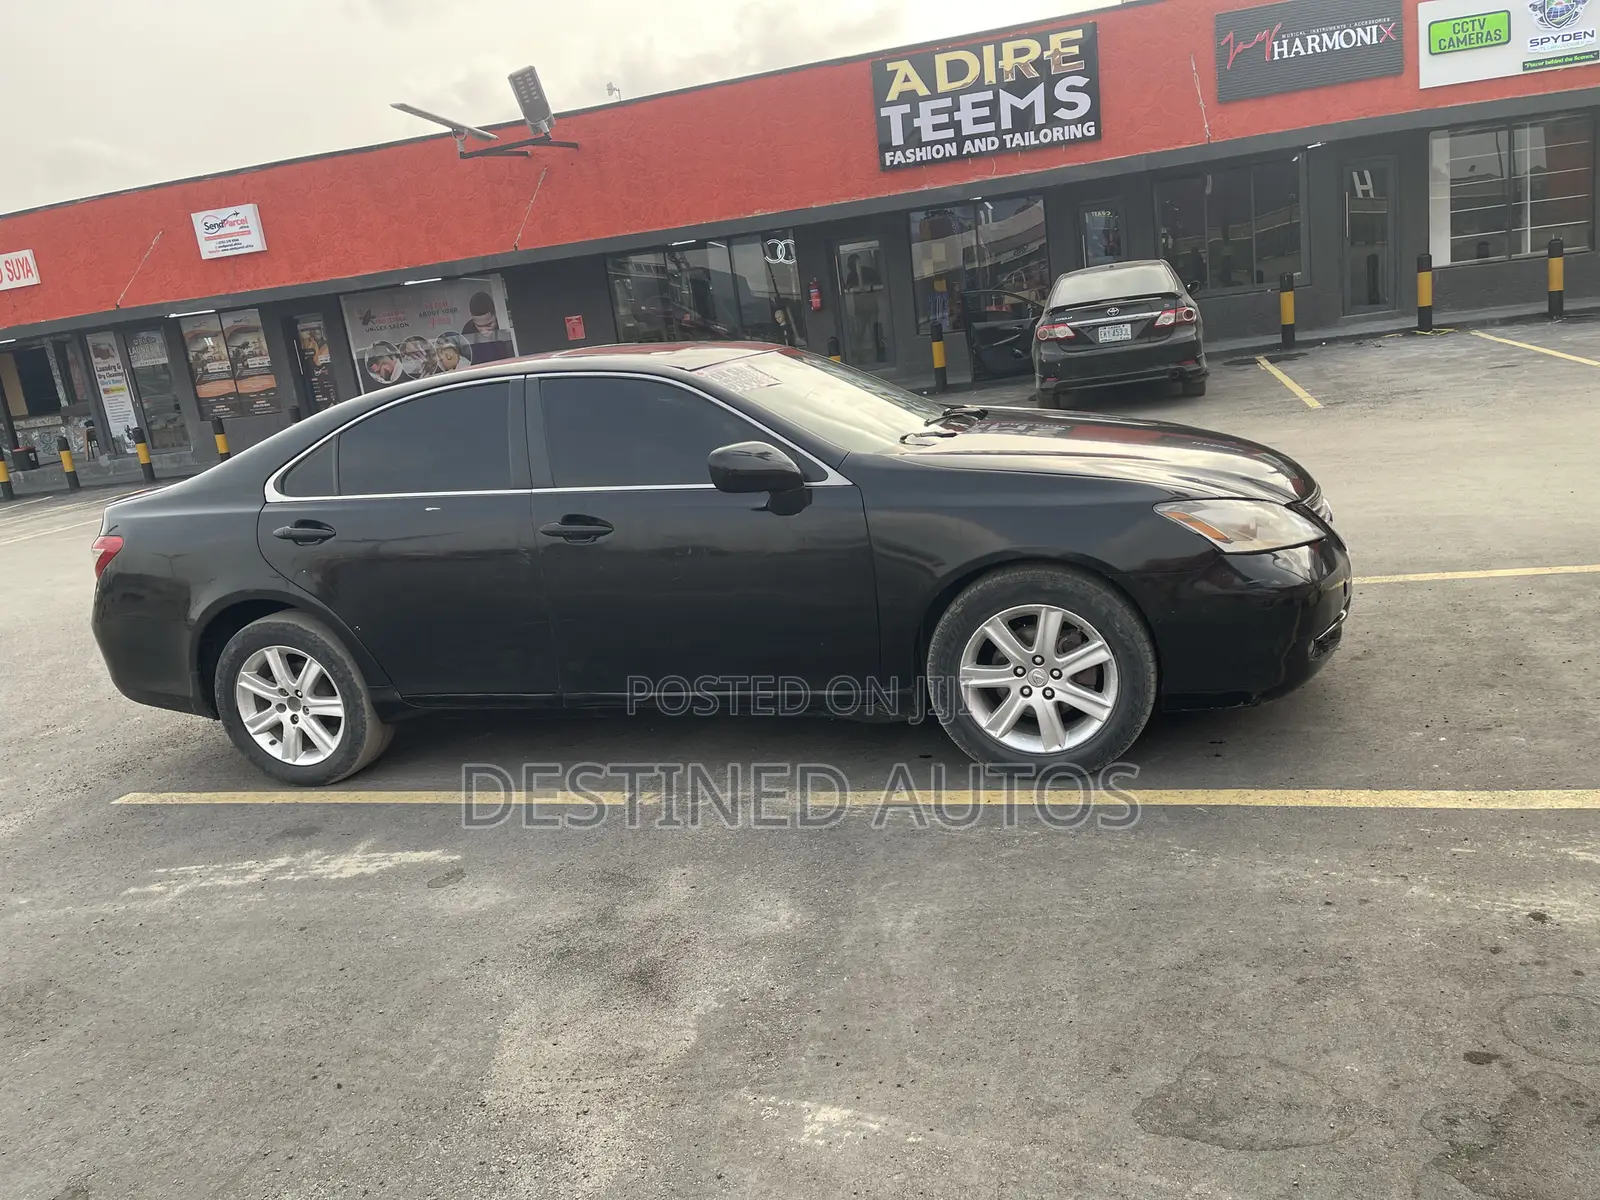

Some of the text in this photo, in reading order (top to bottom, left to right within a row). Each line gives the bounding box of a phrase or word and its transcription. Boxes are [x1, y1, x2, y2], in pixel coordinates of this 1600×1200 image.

[1282, 18, 1390, 38] MUSICAL INSTRUMENTS ACCESSORIES
[1452, 18, 1487, 34] CCTV
[1273, 22, 1396, 60] HARMONIX
[1438, 28, 1502, 50] CAMERAS
[1529, 30, 1595, 48] SPYDEN
[886, 29, 1084, 102] ADIRE
[1546, 58, 1564, 66] behind
[880, 76, 1092, 146] TEEMS
[885, 122, 1096, 166] FASHION AND TAILORING
[4, 256, 34, 282] SUYA
[418, 309, 439, 318] ABOUT
